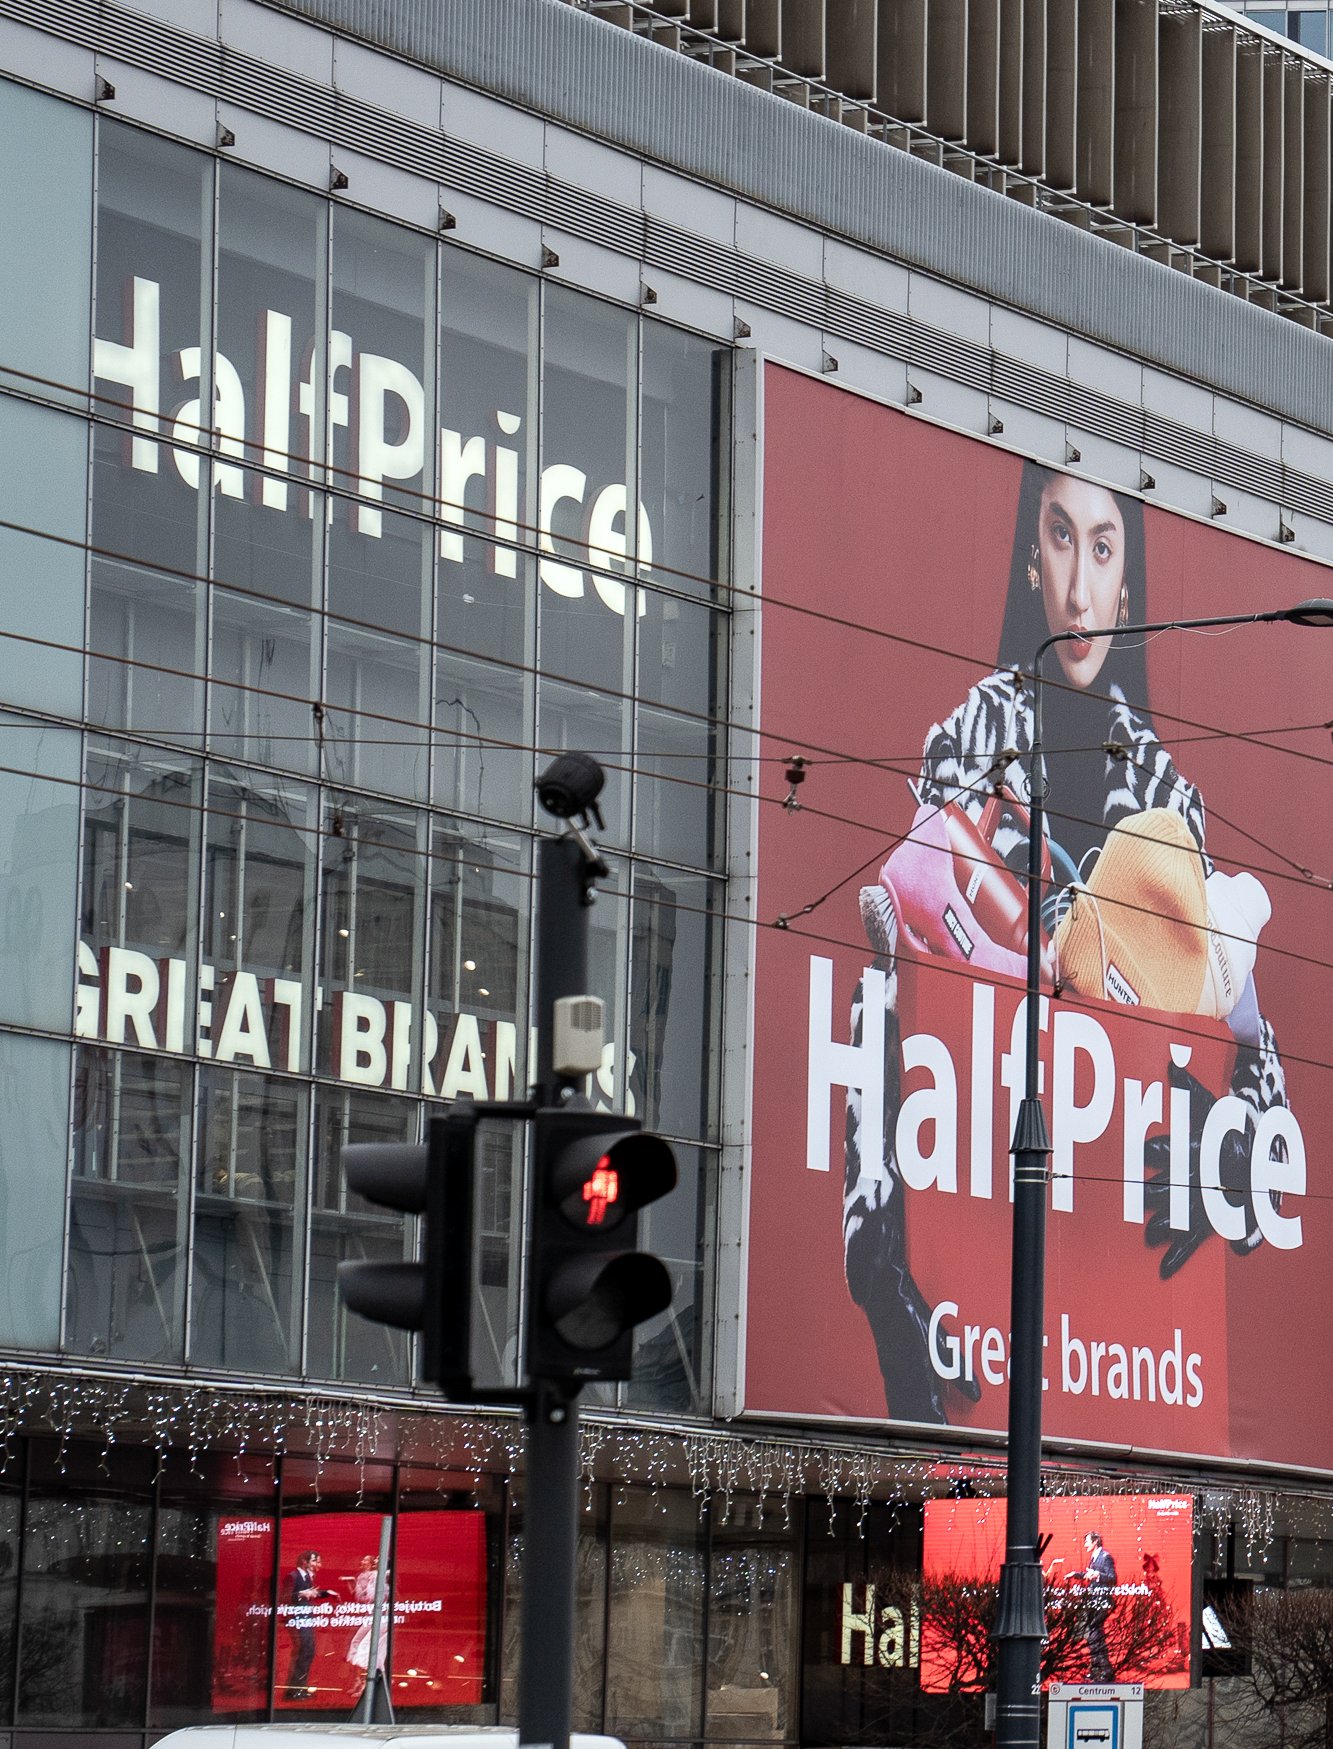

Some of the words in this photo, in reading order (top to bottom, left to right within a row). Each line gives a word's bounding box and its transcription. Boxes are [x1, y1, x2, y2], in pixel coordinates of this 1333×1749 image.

[92, 275, 654, 617] HalfPrice
[333, 990, 642, 1119] BRANS
[806, 955, 1307, 1251] HalfPrice
[928, 1300, 1048, 1391] Gre
[1061, 1313, 1204, 1408] brands
[1078, 1687, 1116, 1695] Centrum
[1131, 1687, 1141, 1695] 12
